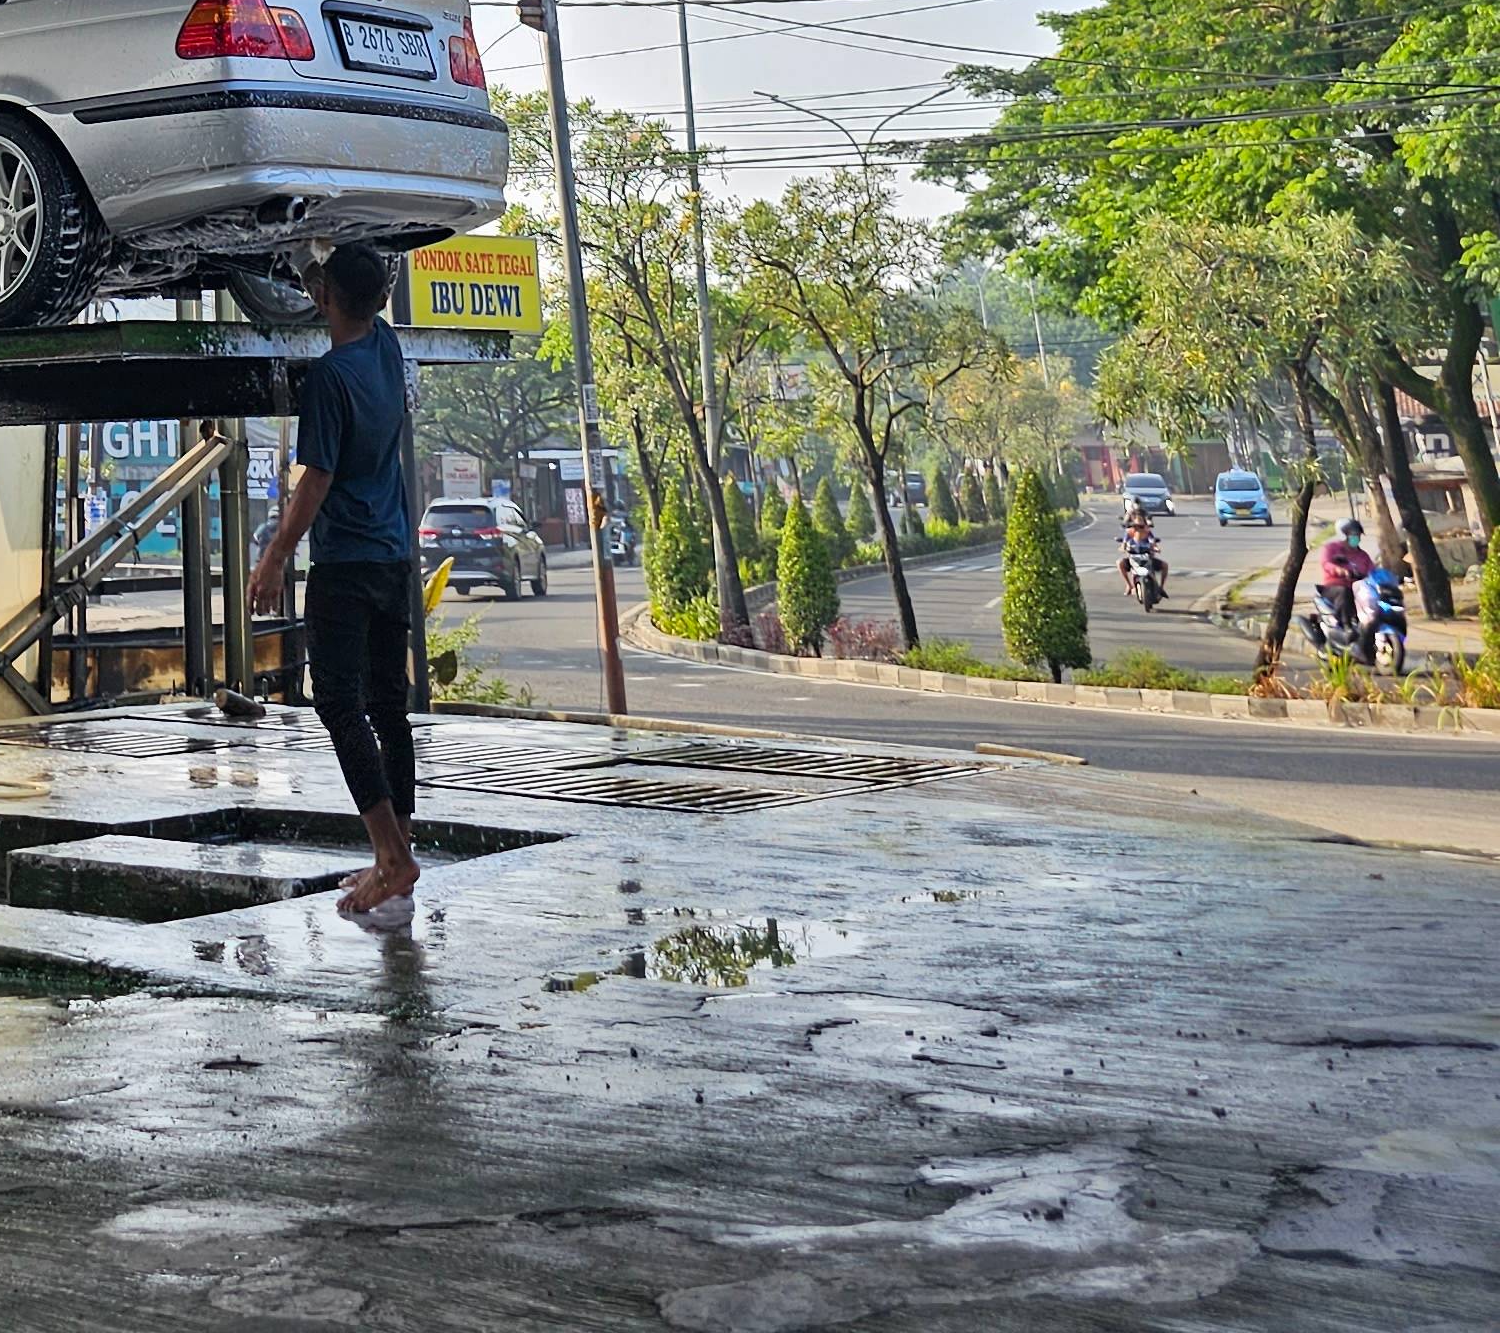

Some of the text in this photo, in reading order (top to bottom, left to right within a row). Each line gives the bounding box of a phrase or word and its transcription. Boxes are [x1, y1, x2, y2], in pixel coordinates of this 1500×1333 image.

[342, 22, 427, 58] B 2676 SBR
[414, 249, 534, 276] PONDOK SATE TEGAL
[430, 281, 522, 317] IBU DEWI
